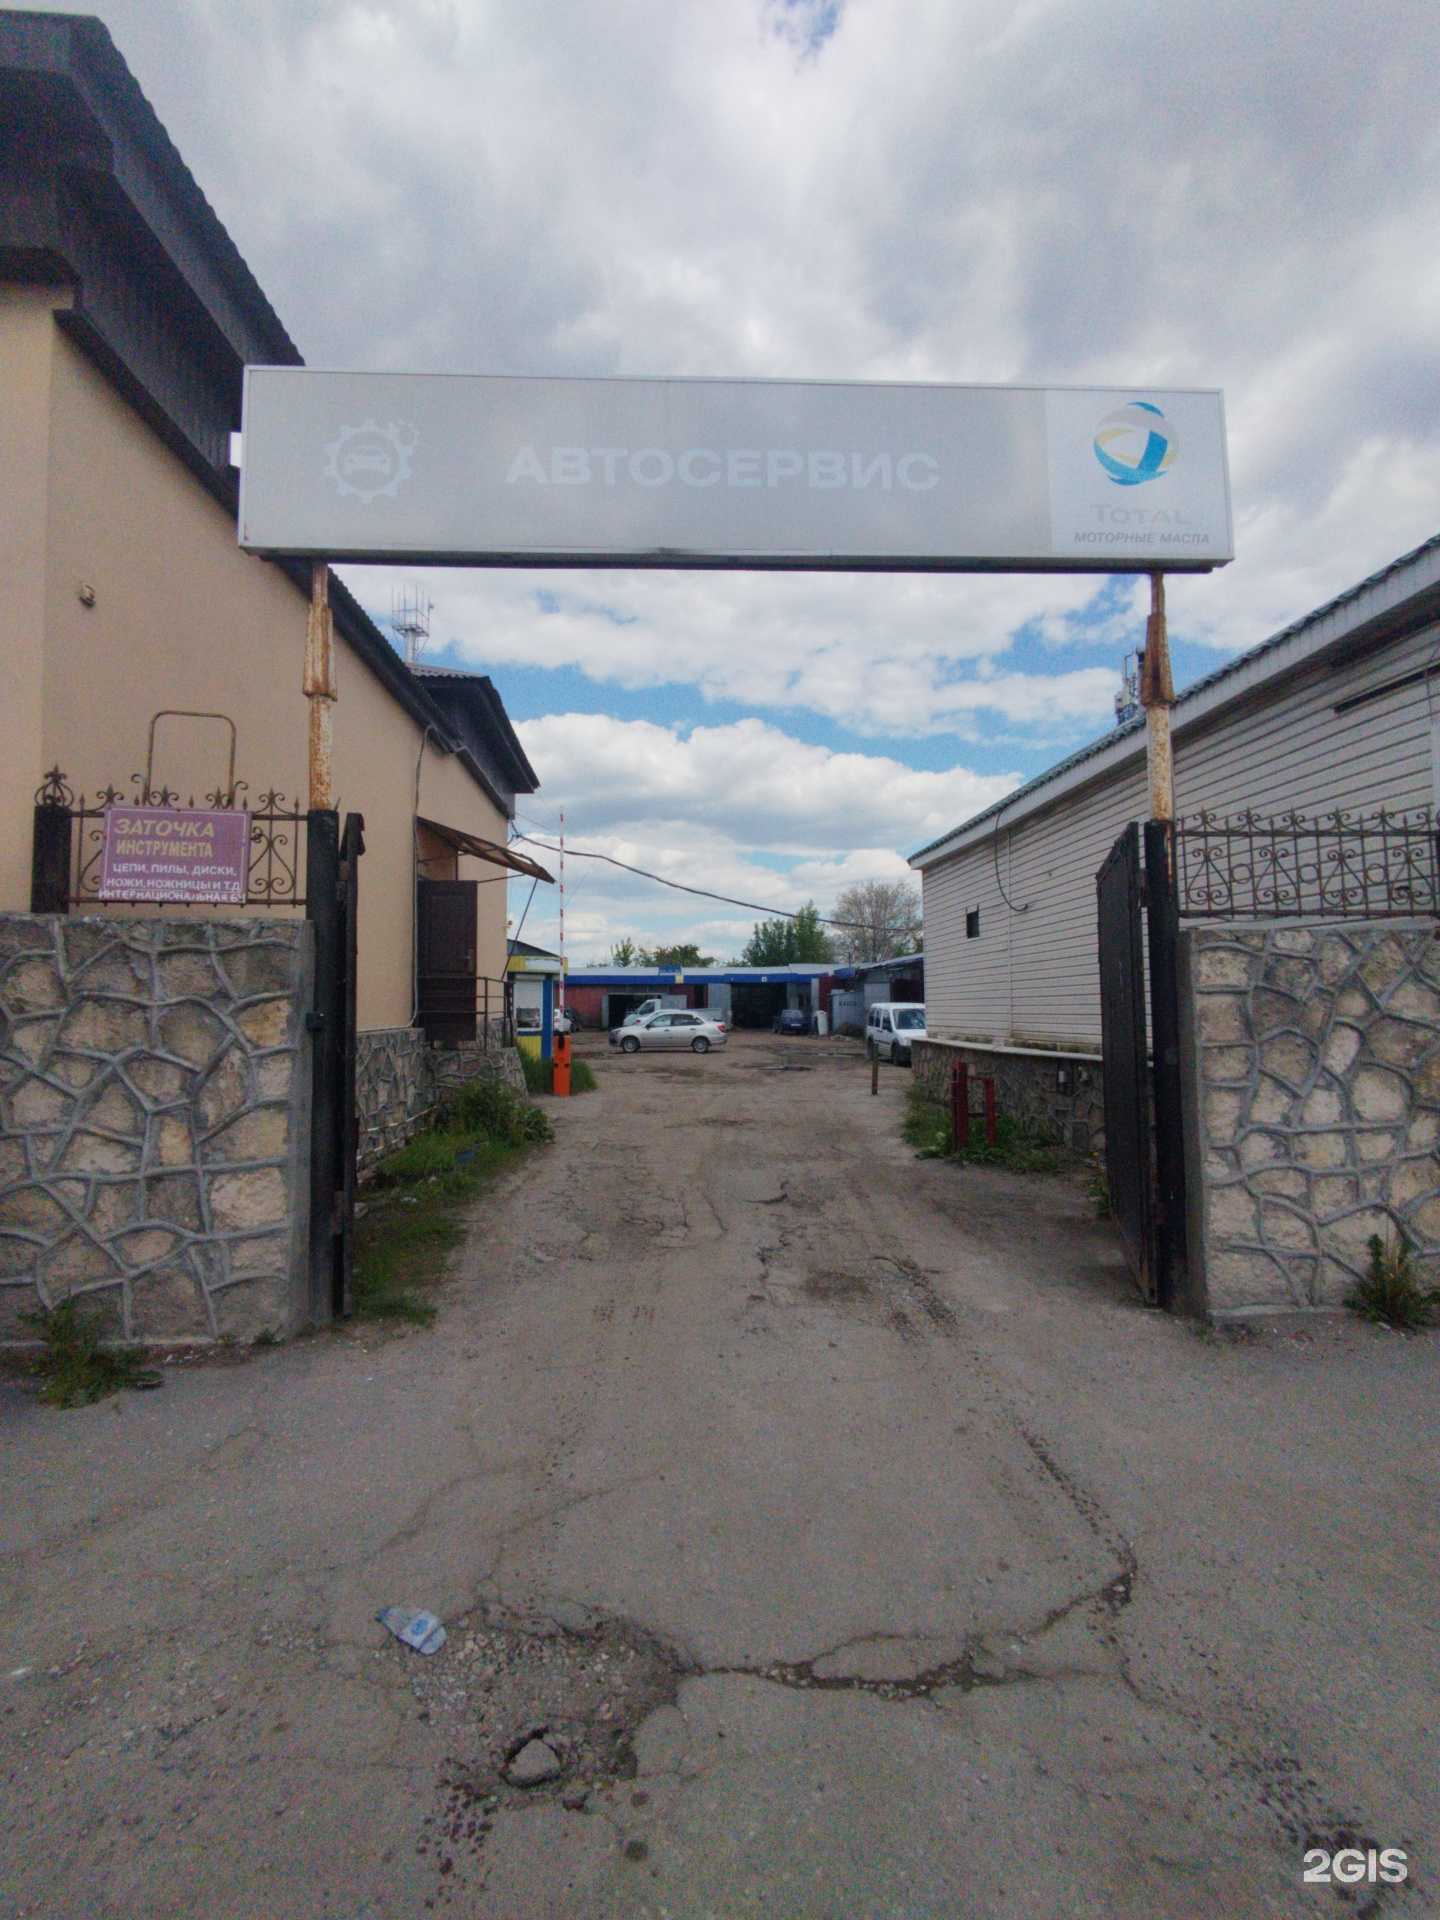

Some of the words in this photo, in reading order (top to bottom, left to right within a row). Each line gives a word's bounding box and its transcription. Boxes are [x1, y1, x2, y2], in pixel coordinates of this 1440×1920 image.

[507, 446, 941, 491] АВТОСЕРВИС
[1074, 532, 1156, 544] МОТОРНЫЕ
[1160, 533, 1210, 544] МАСЛА
[114, 819, 215, 838] ЗАТОЧКА
[116, 840, 213, 858] ИНСТРУМЕНТА
